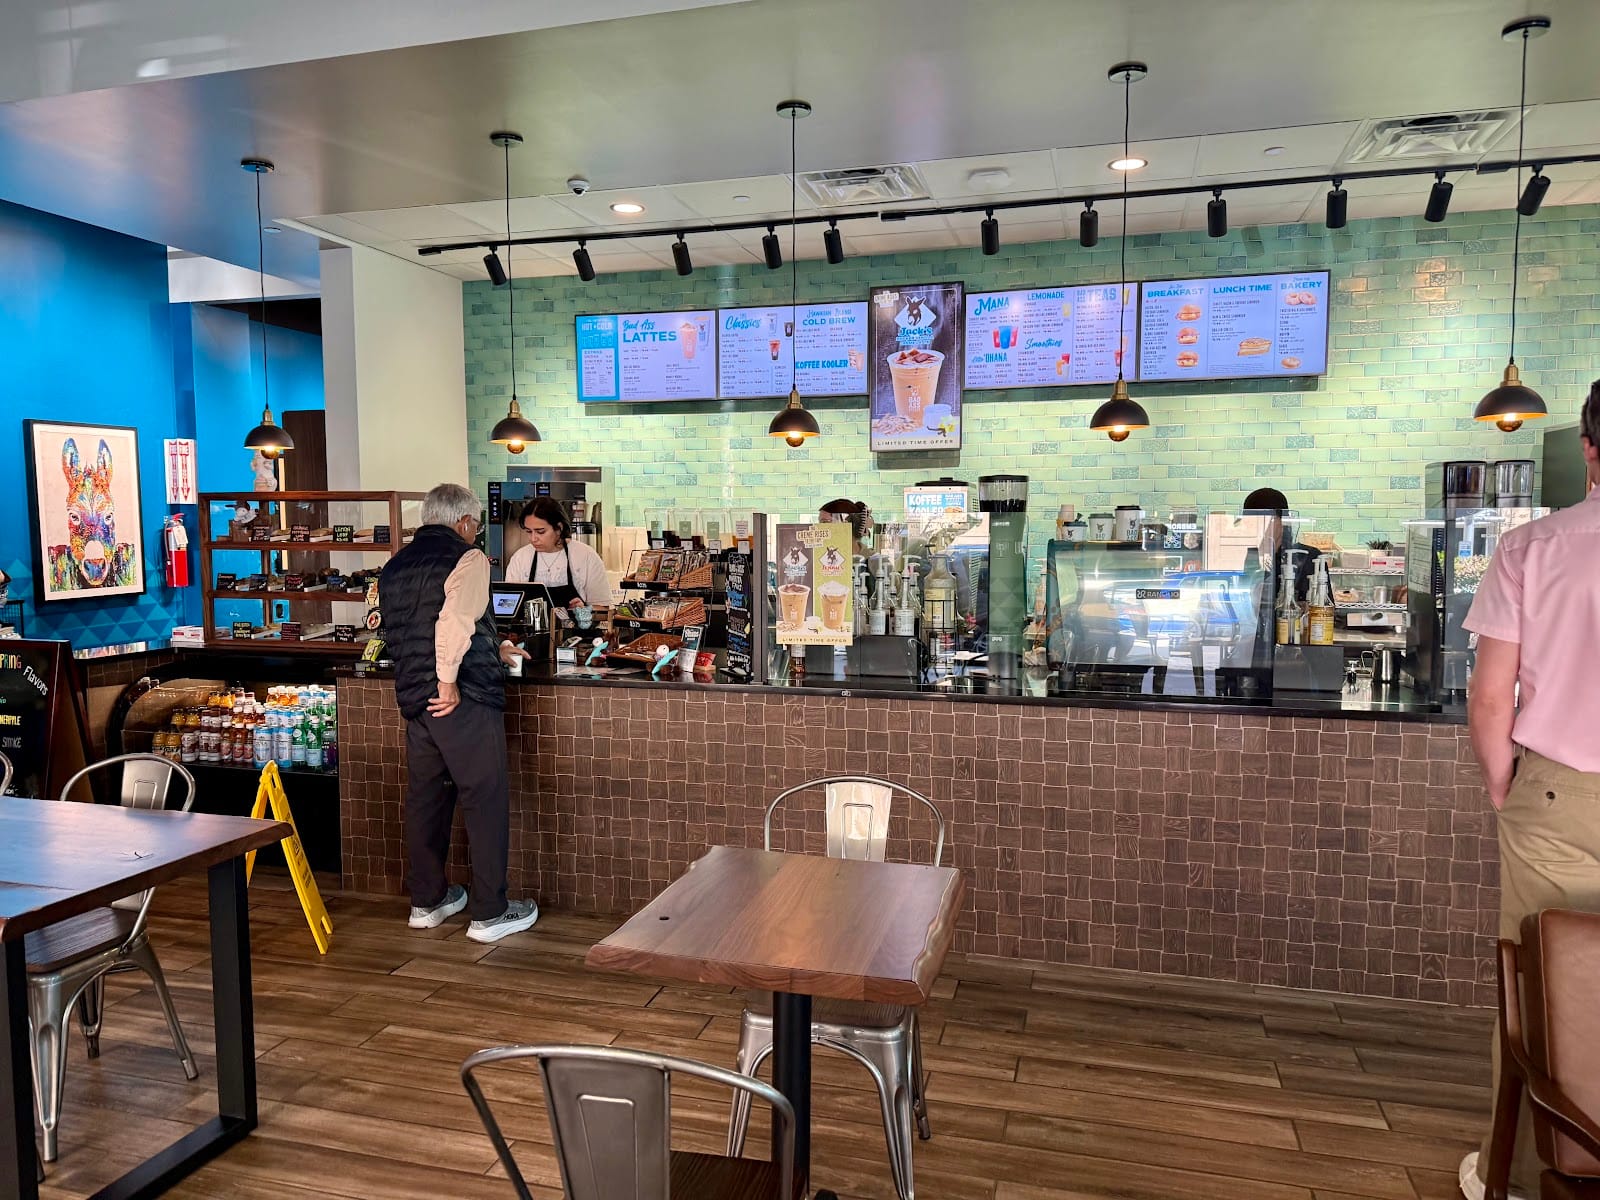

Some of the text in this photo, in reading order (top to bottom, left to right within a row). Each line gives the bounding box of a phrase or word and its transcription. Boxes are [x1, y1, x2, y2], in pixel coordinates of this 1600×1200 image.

[1213, 284, 1273, 294] LUNCH TIME
[1281, 281, 1322, 290] BAKERY
[1027, 291, 1065, 301] LEMONADE
[1147, 288, 1204, 297] BREAKFAST
[974, 296, 1010, 316] MANA
[725, 315, 761, 330] Classics
[802, 316, 856, 326] COLD BREW
[623, 331, 677, 343] LATTES
[1025, 338, 1063, 350] Smoothies
[795, 359, 849, 369] KOFFEE KOOLER
[908, 494, 943, 506] KOFFEE
[23, 665, 49, 696] Flavors
[504, 912, 520, 920] HOKA
